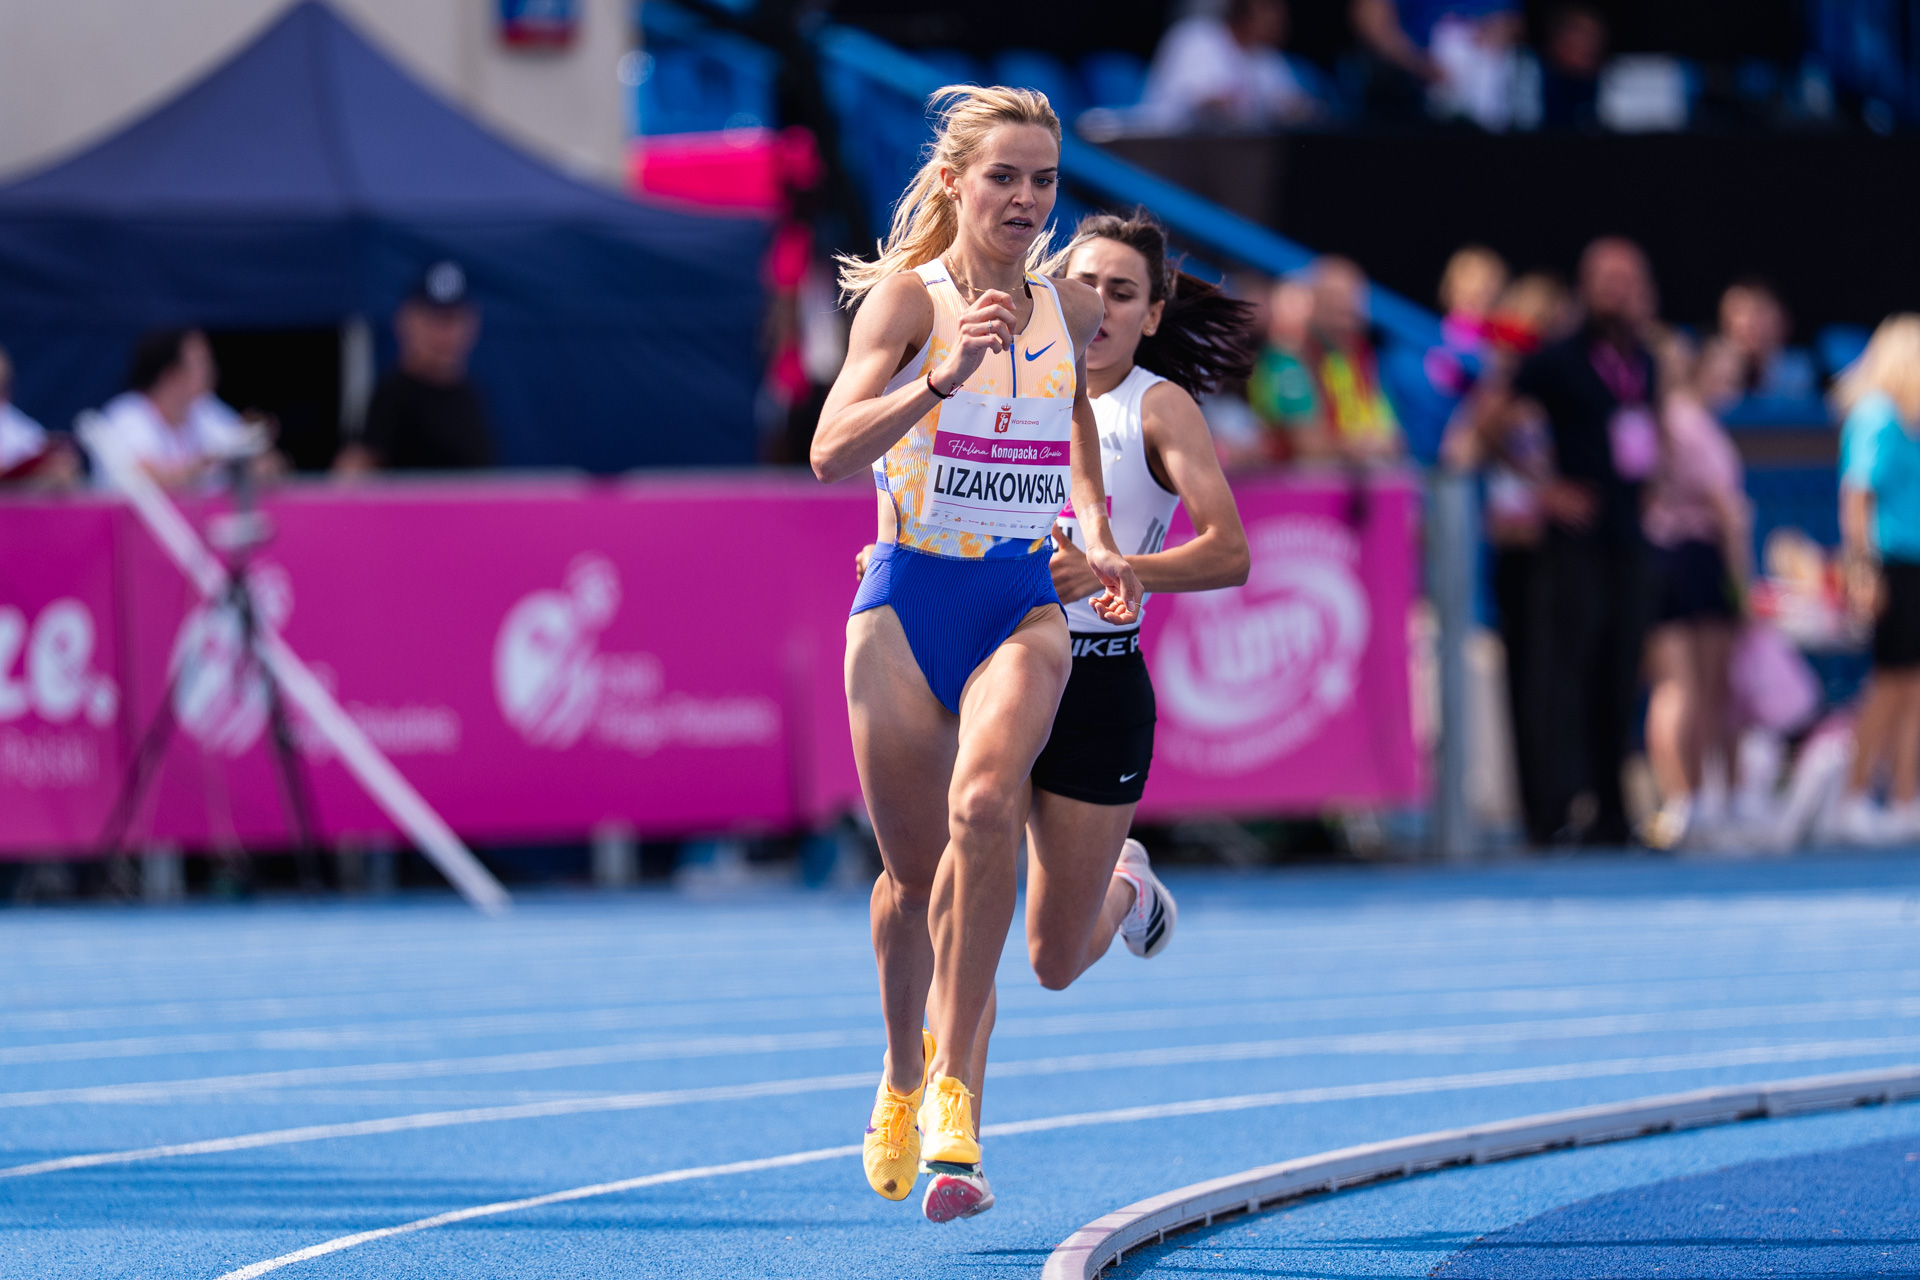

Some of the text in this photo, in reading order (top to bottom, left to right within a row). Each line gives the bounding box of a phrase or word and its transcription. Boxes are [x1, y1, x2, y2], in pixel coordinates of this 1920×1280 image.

[1011, 418, 1039, 426] Warszawa
[948, 439, 1062, 462] Halina Konopacka Classic
[934, 464, 1066, 504] LIZAKOWSKA
[1071, 636, 1128, 657] IKE
